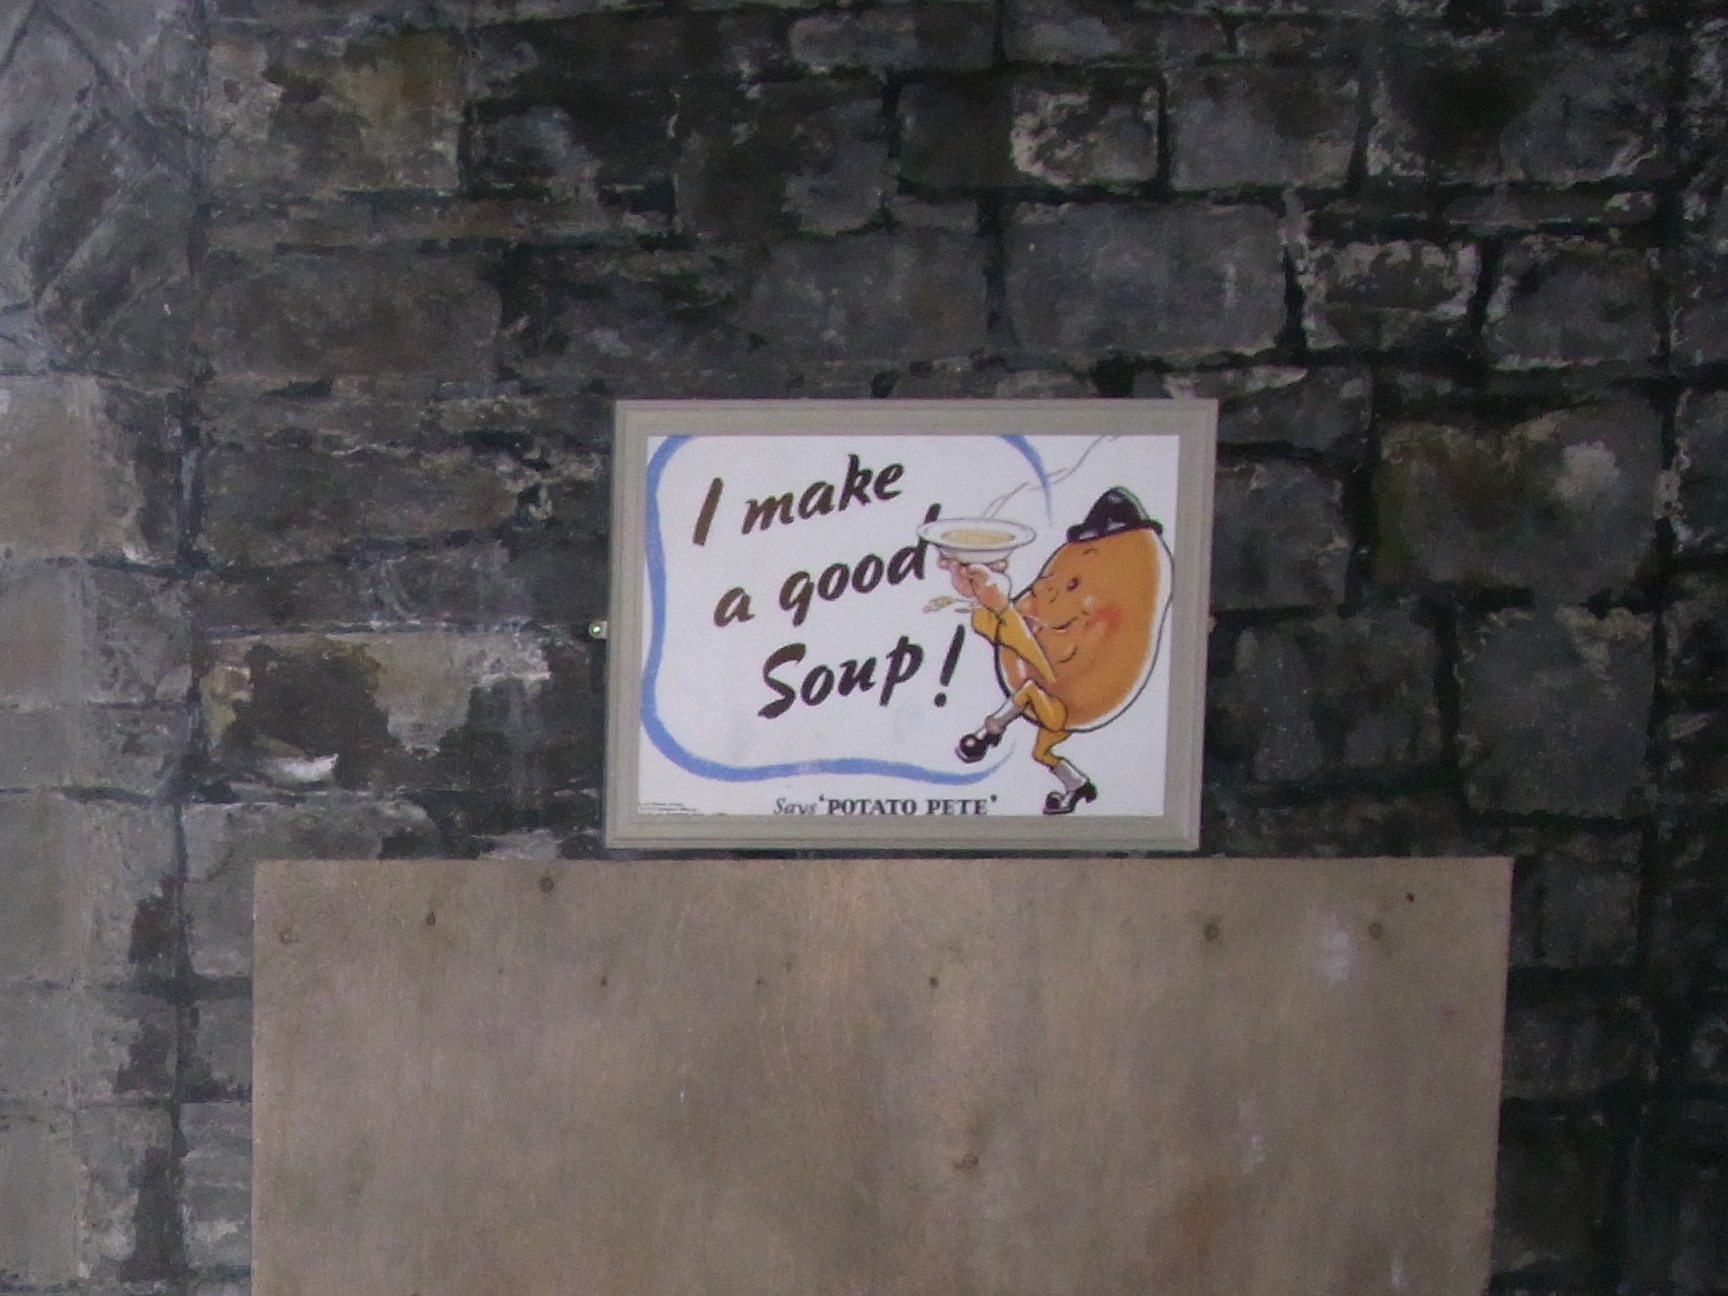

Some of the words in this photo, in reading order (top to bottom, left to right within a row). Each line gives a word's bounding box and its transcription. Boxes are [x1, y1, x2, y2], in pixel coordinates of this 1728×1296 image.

[691, 477, 724, 546] I
[741, 453, 905, 536] make
[713, 586, 755, 627] a
[779, 503, 942, 626] good
